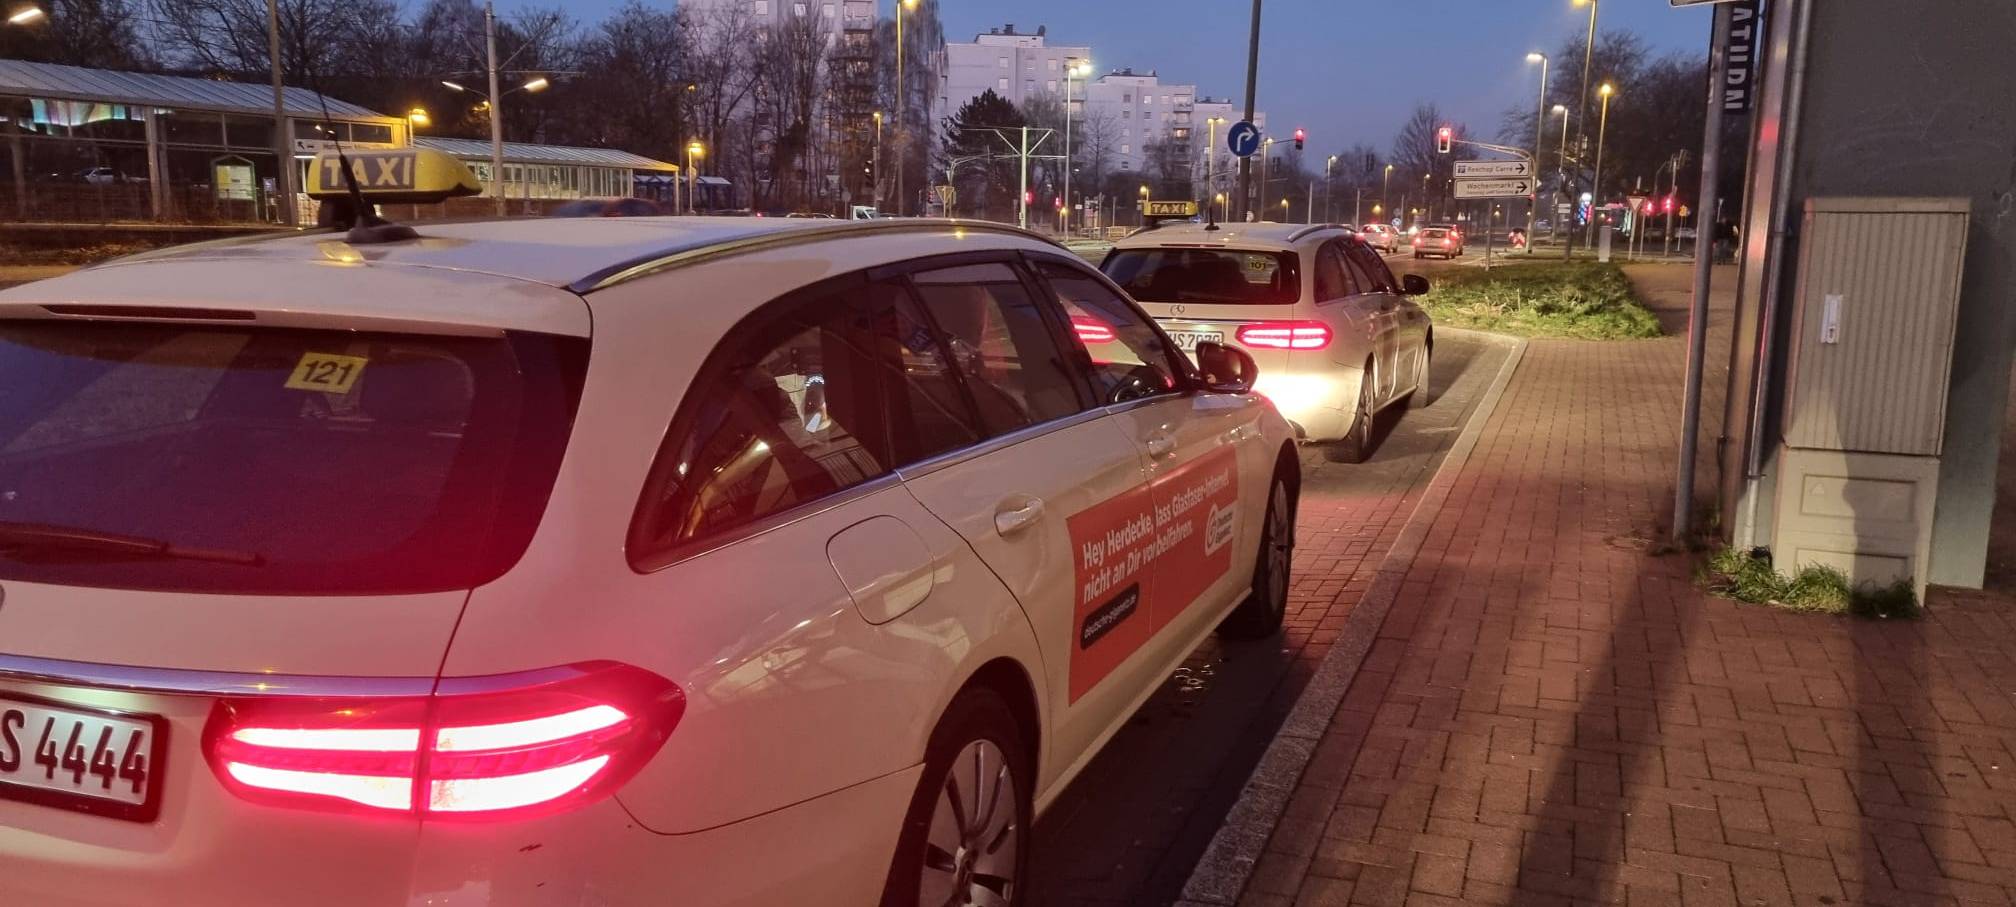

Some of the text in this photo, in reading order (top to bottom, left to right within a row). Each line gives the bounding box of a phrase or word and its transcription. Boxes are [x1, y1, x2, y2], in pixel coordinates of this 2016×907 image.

[324, 156, 412, 187] TAXI
[1152, 204, 1185, 214] TAXI
[303, 359, 357, 386] 121
[1083, 540, 1105, 570] Hey
[1106, 513, 1154, 556] Herdecke,
[1155, 503, 1171, 527] lass
[1083, 566, 1112, 605] nicht
[1112, 561, 1126, 585] an
[1126, 547, 1142, 577] Dir
[0, 709, 146, 794] S 4444
